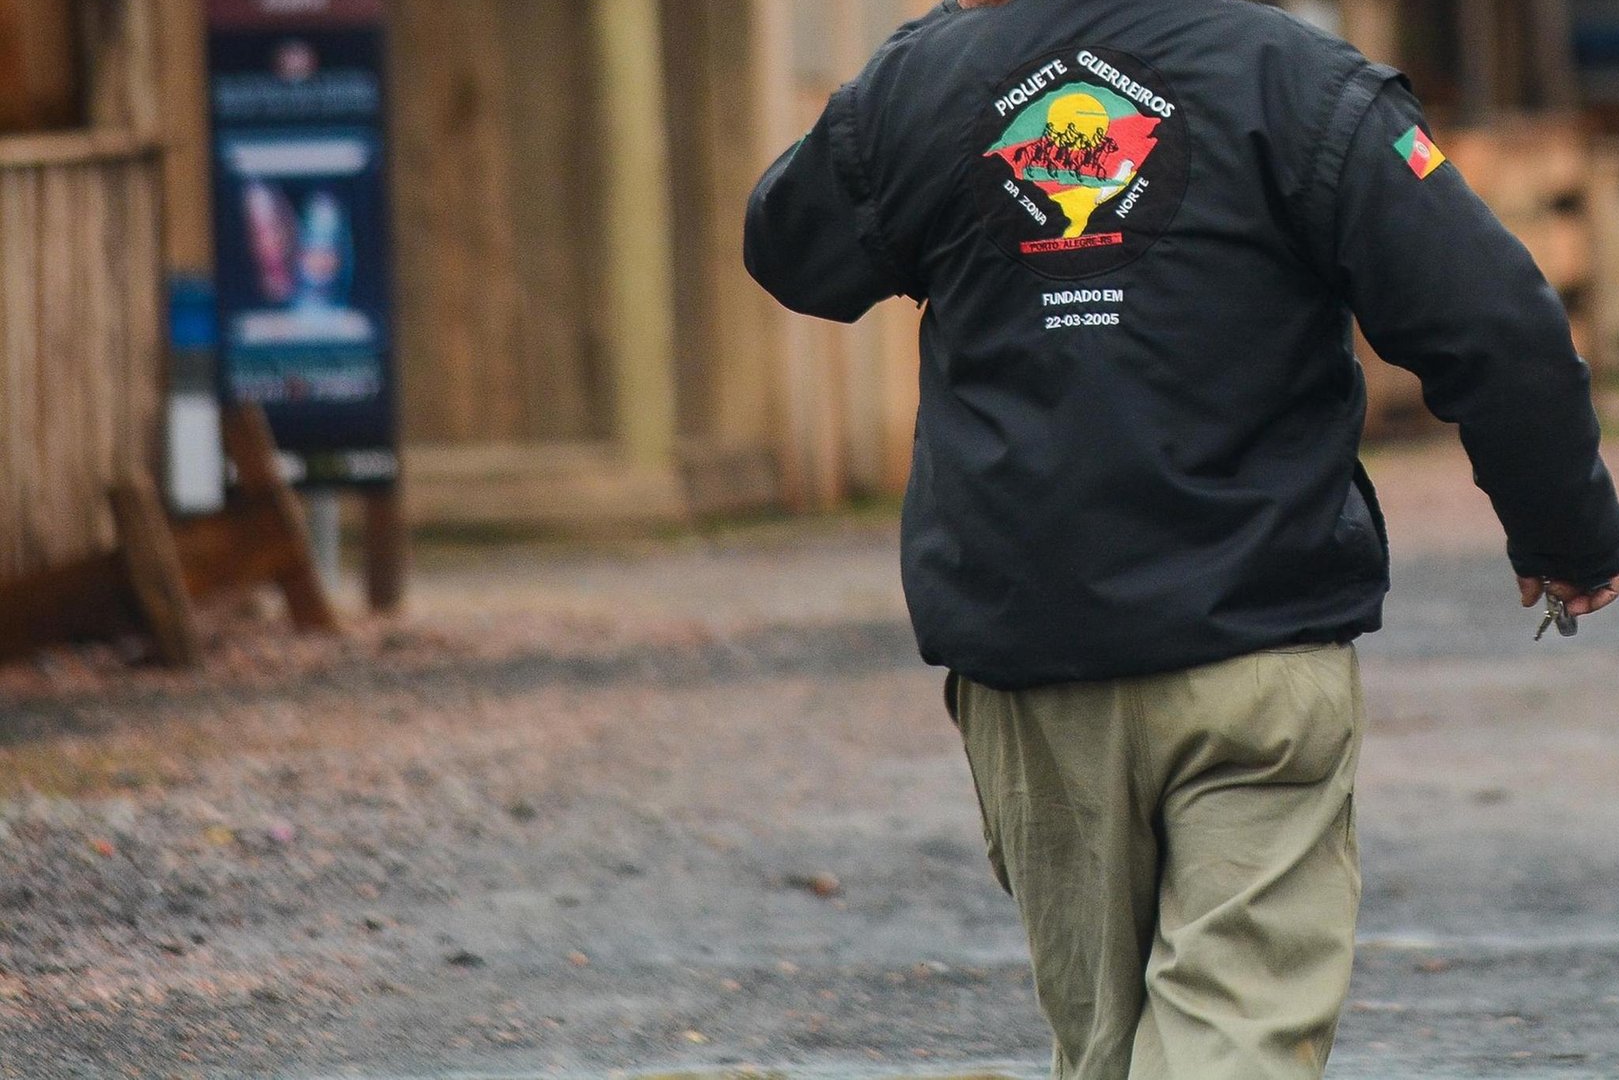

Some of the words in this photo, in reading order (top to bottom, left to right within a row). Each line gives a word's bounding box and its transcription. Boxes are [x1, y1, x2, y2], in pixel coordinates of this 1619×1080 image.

[994, 59, 1068, 117] PIQUETE
[1076, 50, 1175, 118] GUERREIROS
[1003, 179, 1020, 198] DA
[1018, 195, 1048, 226] ZONA
[1115, 177, 1149, 219] NORTE
[1029, 241, 1059, 252] PORTO
[1042, 291, 1101, 306] FUNDADO
[1104, 289, 1124, 302] EM
[1045, 313, 1120, 330] 22-03-2005
